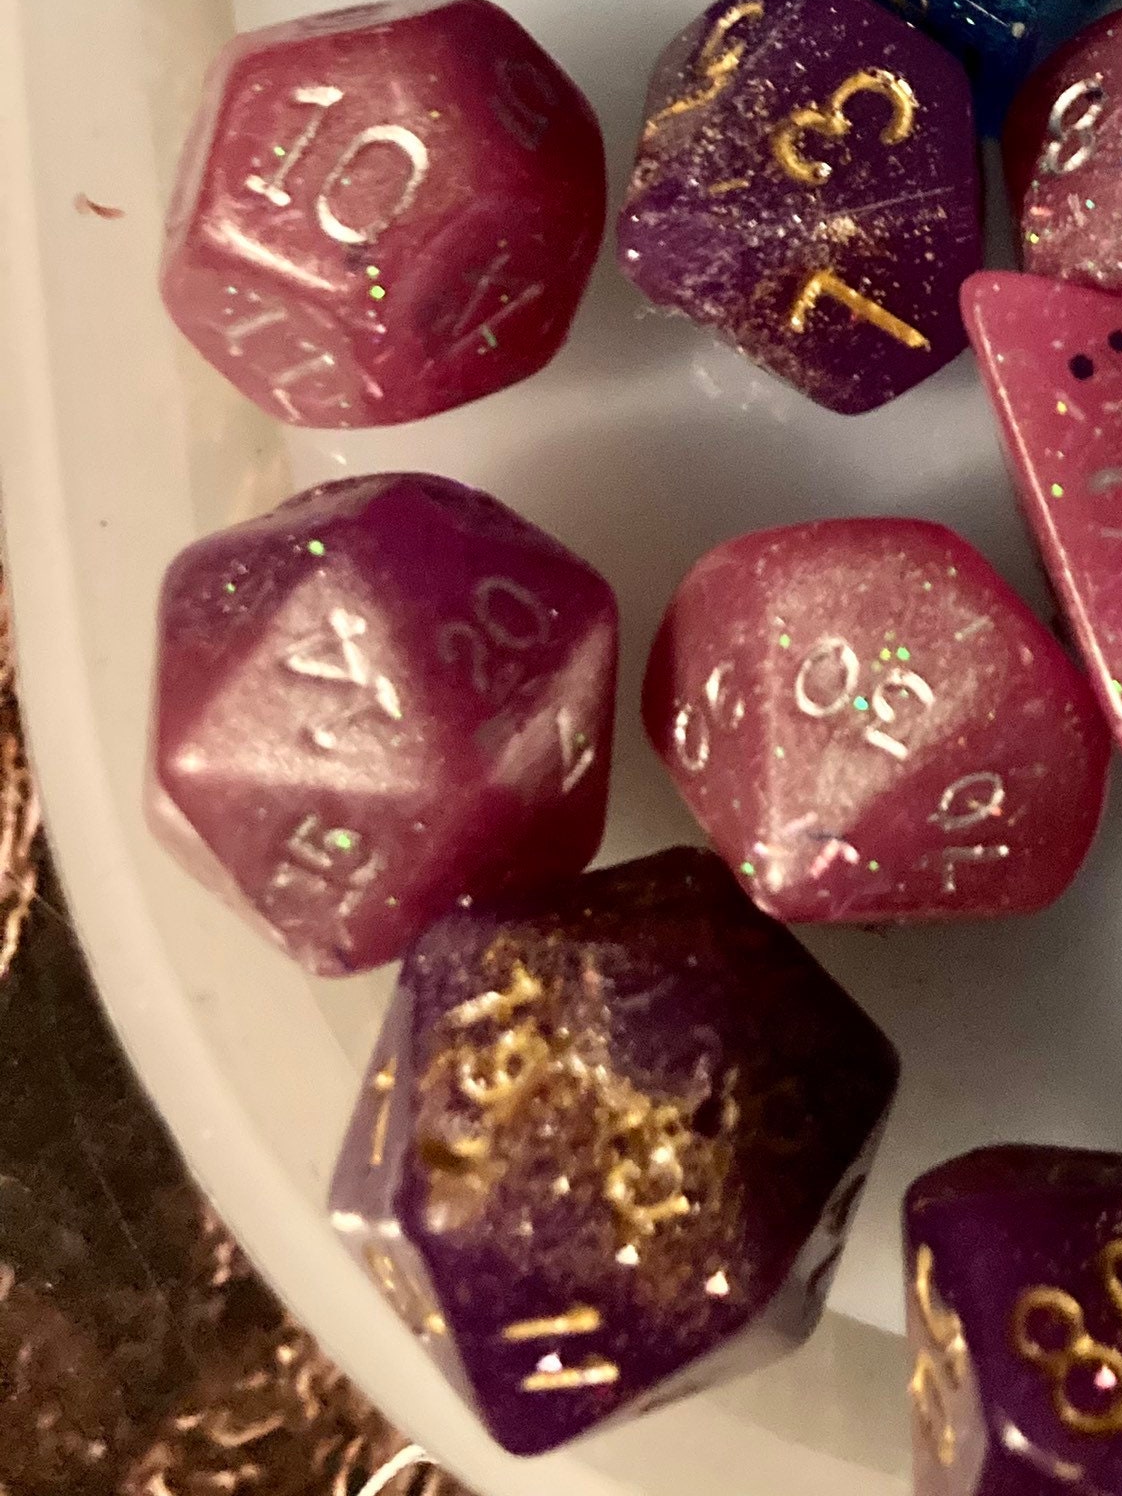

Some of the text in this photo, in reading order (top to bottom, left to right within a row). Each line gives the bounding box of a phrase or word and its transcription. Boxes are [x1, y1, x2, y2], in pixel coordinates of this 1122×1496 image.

[245, 86, 430, 245] 10
[770, 67, 917, 186] 3
[1040, 78, 1104, 175] 8
[787, 267, 931, 353] 7
[437, 575, 552, 697] 20
